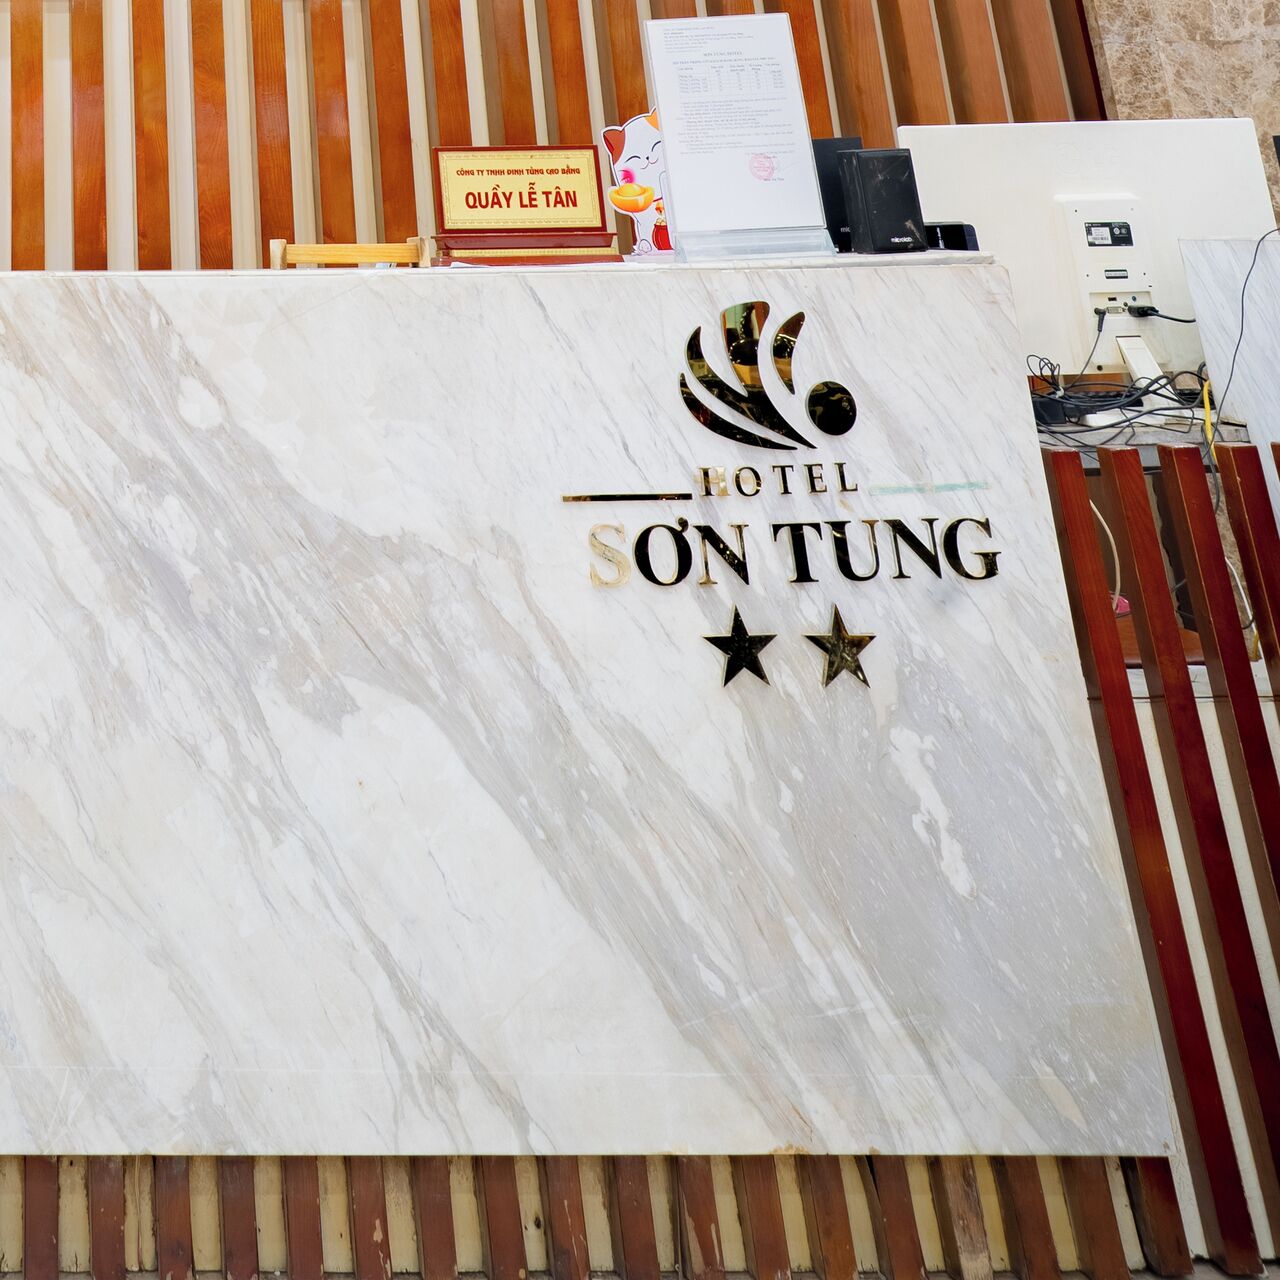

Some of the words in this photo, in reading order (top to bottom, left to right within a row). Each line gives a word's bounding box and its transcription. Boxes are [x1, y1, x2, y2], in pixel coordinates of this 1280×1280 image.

[456, 167, 475, 177] CÔNG
[476, 169, 484, 177] TY
[526, 166, 544, 176] TÙNG
[465, 184, 513, 209] QUẦY
[519, 182, 538, 208] LỄ
[542, 186, 578, 208] TÂN
[697, 462, 859, 498] HOTEL
[588, 516, 750, 588] SƠN
